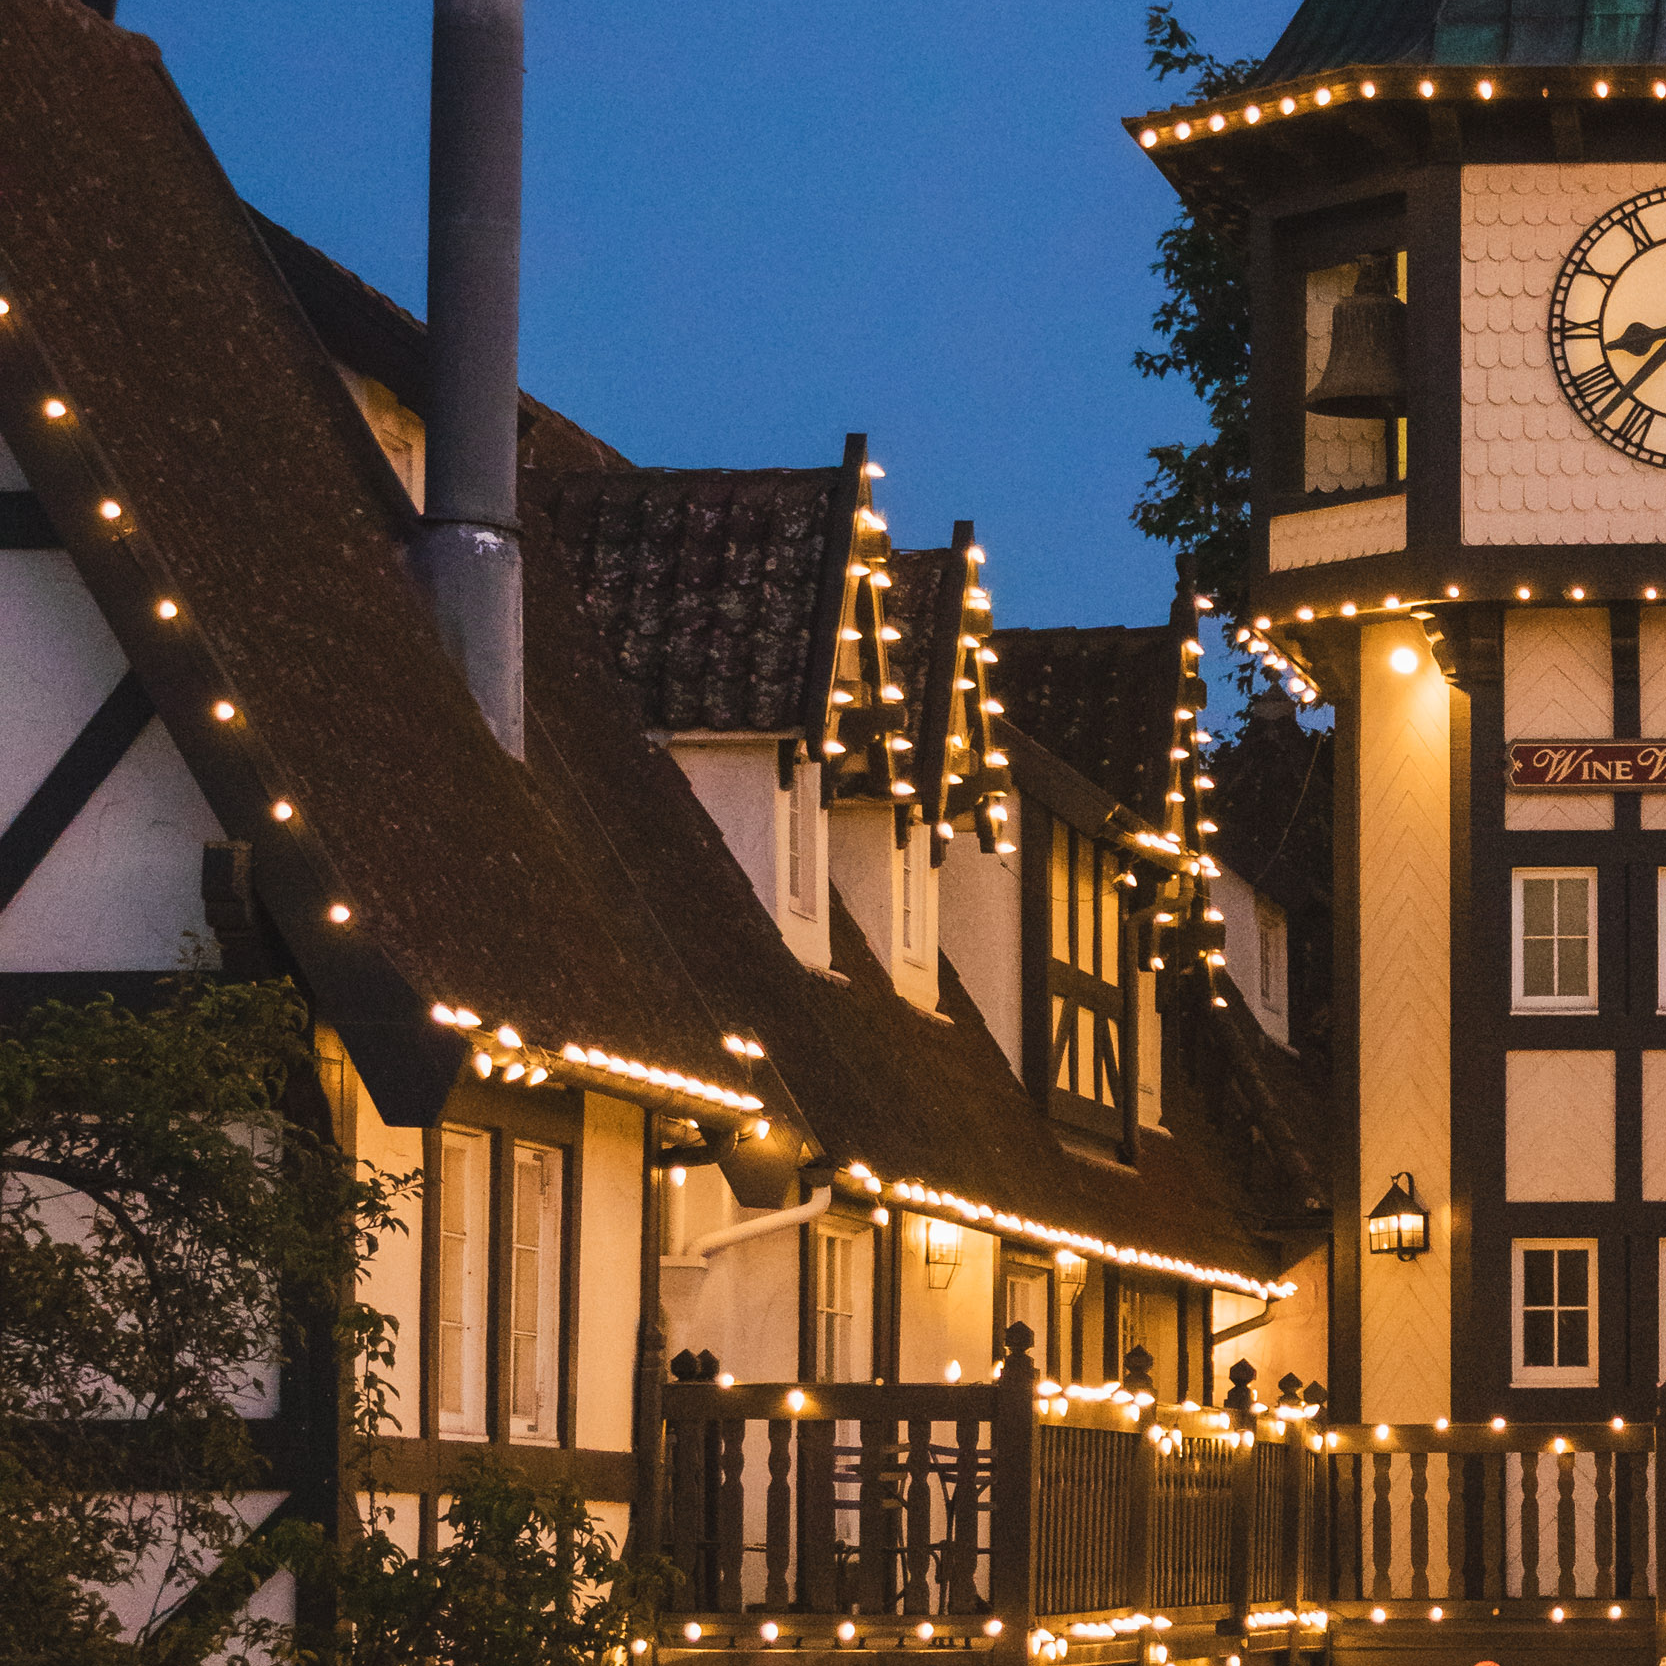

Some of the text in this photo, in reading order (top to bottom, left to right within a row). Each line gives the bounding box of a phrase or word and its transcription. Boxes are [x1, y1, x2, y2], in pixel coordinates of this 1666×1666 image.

[1617, 210, 1656, 255] XI
[1573, 256, 1617, 291] X
[1562, 317, 1602, 340] IX
[1572, 362, 1619, 408] VIII
[1616, 401, 1656, 449] VII
[1533, 747, 1634, 783] WINE
